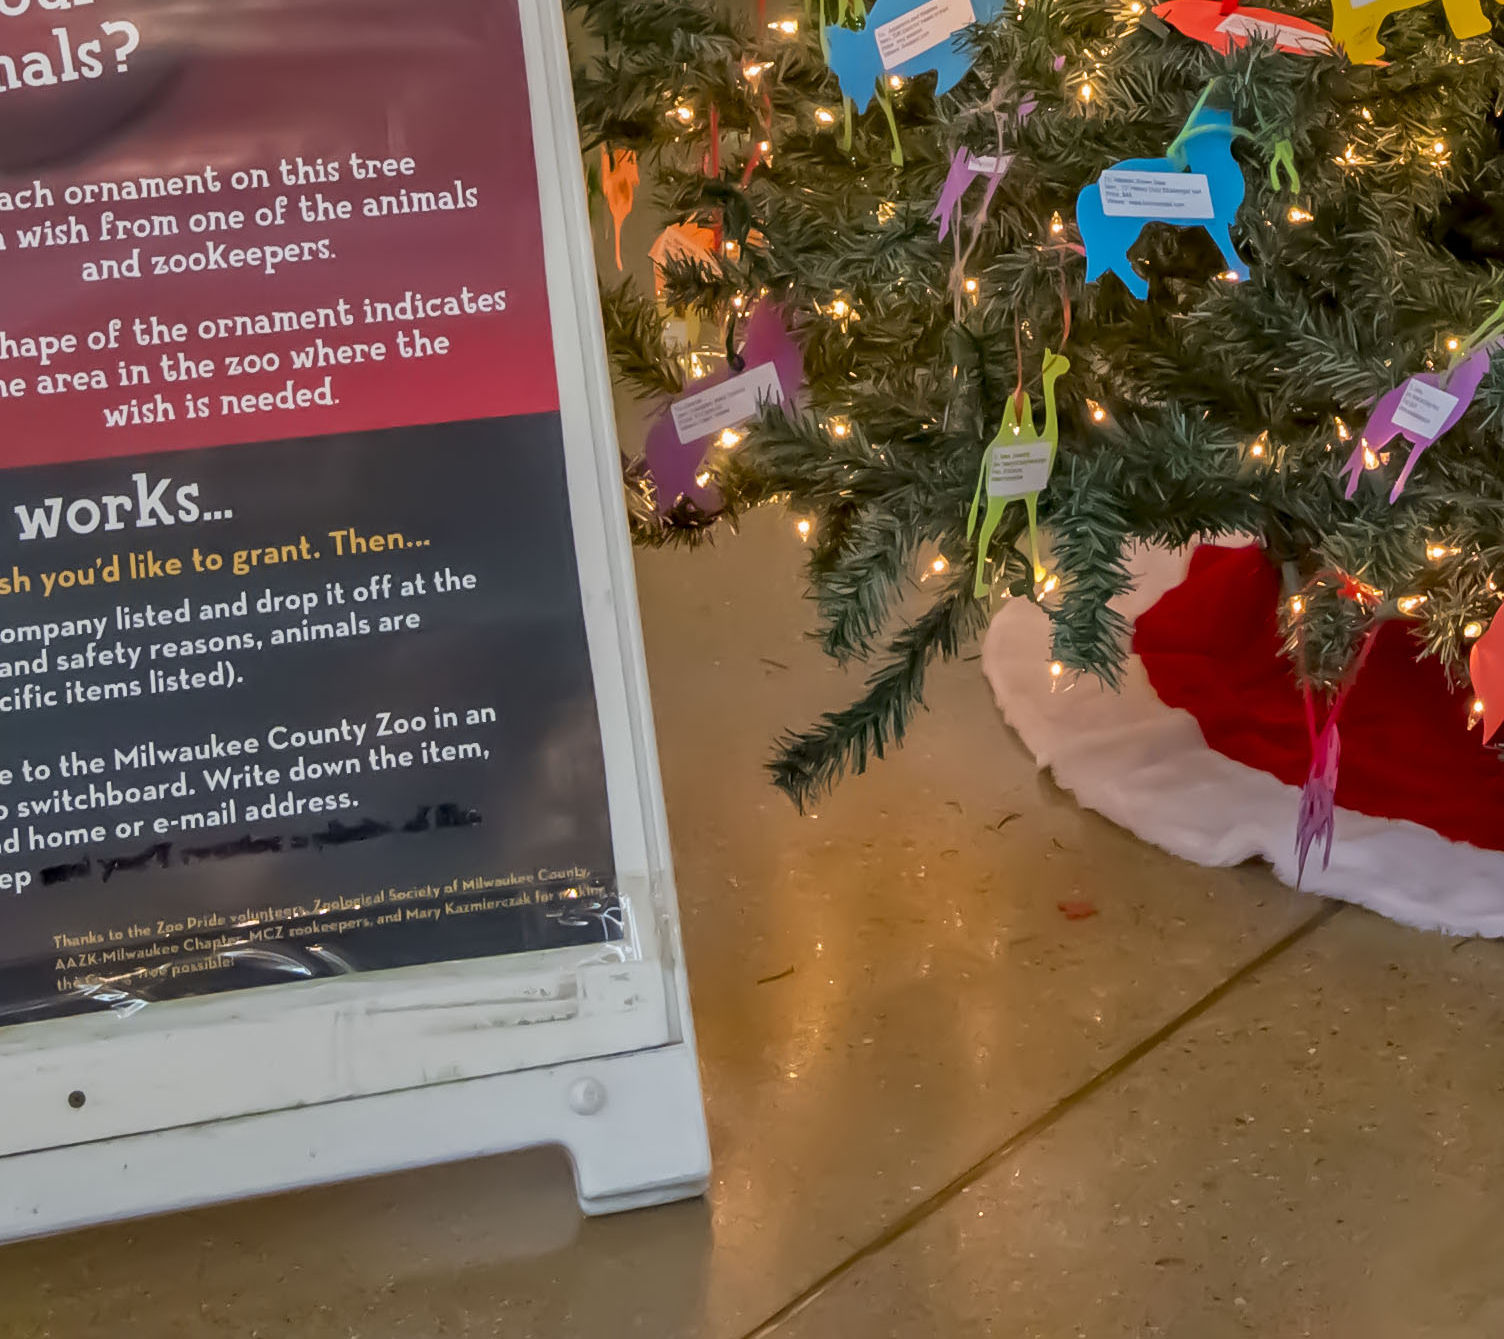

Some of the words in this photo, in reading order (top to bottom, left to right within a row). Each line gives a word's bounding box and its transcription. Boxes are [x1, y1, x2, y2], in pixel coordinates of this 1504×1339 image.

[64, 165, 222, 205] ornament
[230, 169, 271, 190] on
[278, 157, 340, 186] this
[348, 152, 416, 180] tree
[16, 215, 90, 249] wish
[99, 211, 180, 241] from
[188, 210, 245, 233] one
[254, 195, 288, 227] of
[298, 193, 353, 223] the
[362, 179, 478, 217] animals
[81, 248, 142, 282] and
[150, 238, 336, 275] zookeepers.
[87, 318, 122, 350] of
[132, 316, 188, 346] the
[198, 298, 354, 340] ornament
[362, 286, 506, 324] indicates
[36, 369, 109, 395] area
[117, 360, 151, 386] in
[159, 352, 215, 382] the
[224, 352, 280, 376] zoo
[289, 338, 387, 369] where
[396, 328, 450, 358] the
[102, 393, 176, 428] wish
[184, 393, 210, 419] is
[219, 375, 340, 415] needed.
[129, 550, 183, 580] like
[191, 548, 223, 572] to
[232, 535, 321, 576] grant.
[115, 598, 191, 631] listed
[199, 590, 248, 621] and
[256, 588, 319, 615] drop
[326, 582, 346, 606] it
[352, 573, 392, 602] off
[400, 572, 427, 597] at
[433, 567, 477, 593] the
[56, 641, 142, 671] safety
[150, 632, 263, 660] reasons,
[270, 611, 371, 645] animals
[378, 613, 421, 632] are
[65, 680, 142, 704] items
[149, 660, 244, 694] listed).
[21, 759, 51, 783] to
[58, 751, 106, 778] the
[114, 733, 260, 771] Milwaukee
[267, 718, 367, 750] County
[375, 711, 427, 737] Zoo
[434, 712, 458, 729] in
[465, 707, 497, 725] an
[17, 771, 196, 818] switchboard.
[202, 764, 281, 792] Write
[289, 756, 361, 782] down
[368, 744, 414, 771] the
[421, 740, 490, 765] item,
[28, 825, 107, 851] home
[115, 820, 145, 839] or
[153, 798, 237, 834] e-mail
[245, 790, 359, 822] address.
[53, 931, 105, 950] Thanks
[127, 924, 152, 939] the
[187, 911, 227, 931] Pride
[388, 883, 441, 903] Society
[462, 871, 535, 893] Milwaukee
[377, 909, 403, 926] and
[406, 905, 442, 921] Mary
